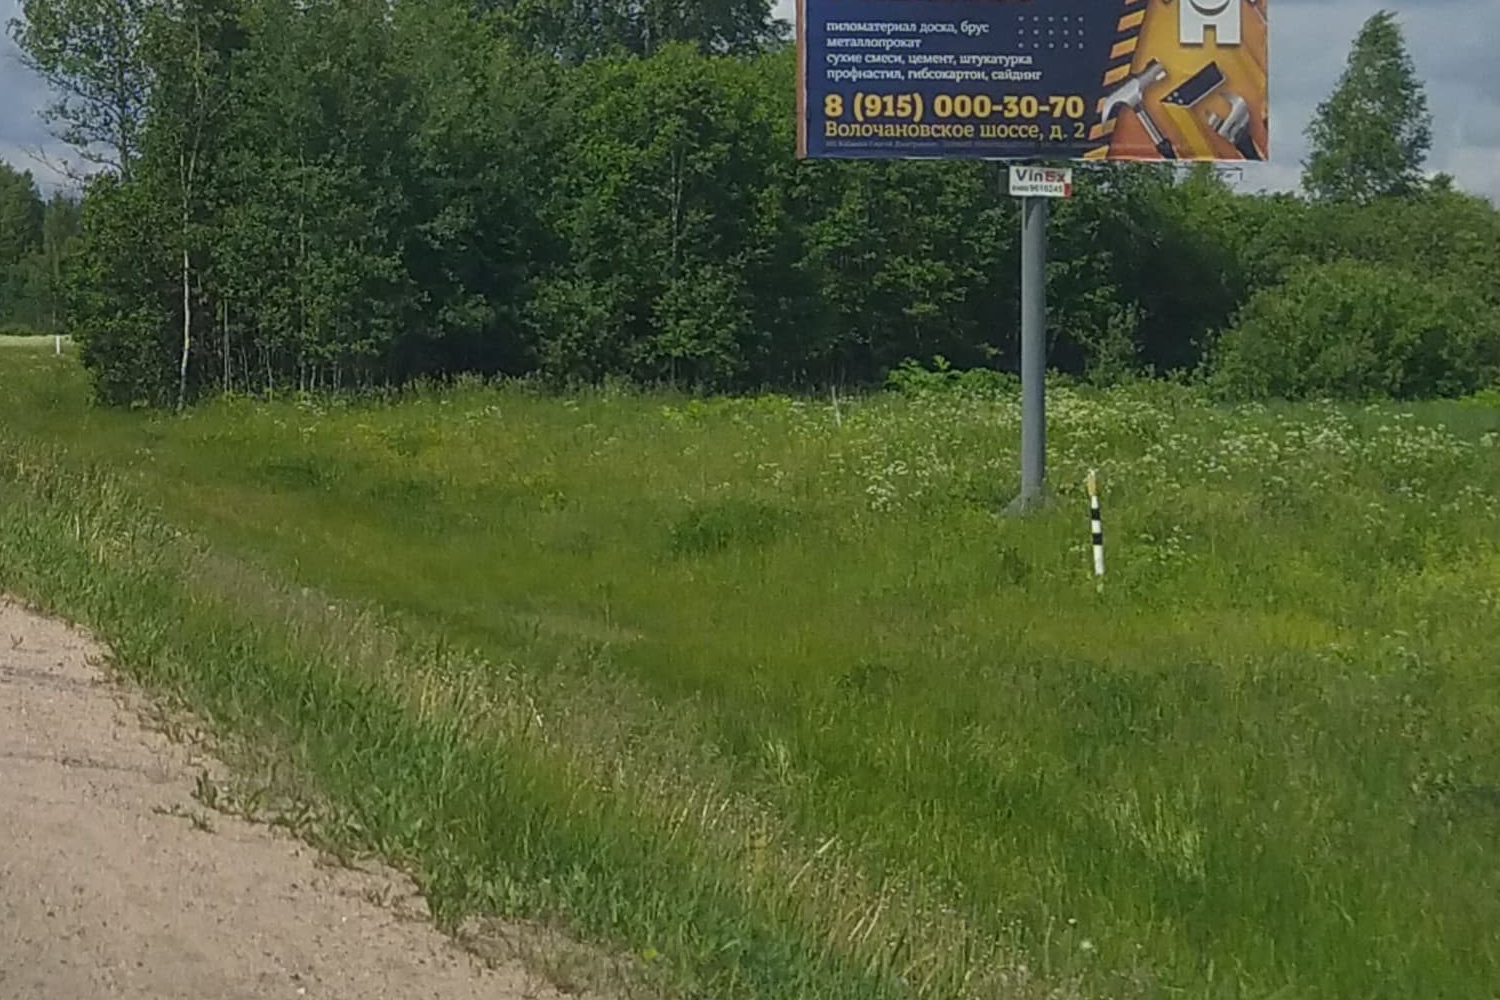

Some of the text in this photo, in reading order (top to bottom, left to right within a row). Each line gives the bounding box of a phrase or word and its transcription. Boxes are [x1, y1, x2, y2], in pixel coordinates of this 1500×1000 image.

[826, 21, 917, 36] пиломатериал
[960, 19, 990, 36] брус
[826, 37, 922, 51] металлопрокат
[826, 53, 862, 66] сухие
[959, 55, 1033, 68] штукатурка
[826, 65, 905, 83] профнастил,
[991, 68, 1042, 81] сайдинг
[824, 91, 1085, 122] 8 (915) 000-30-70
[825, 120, 1085, 141] Волочановское шоссе, д. 2
